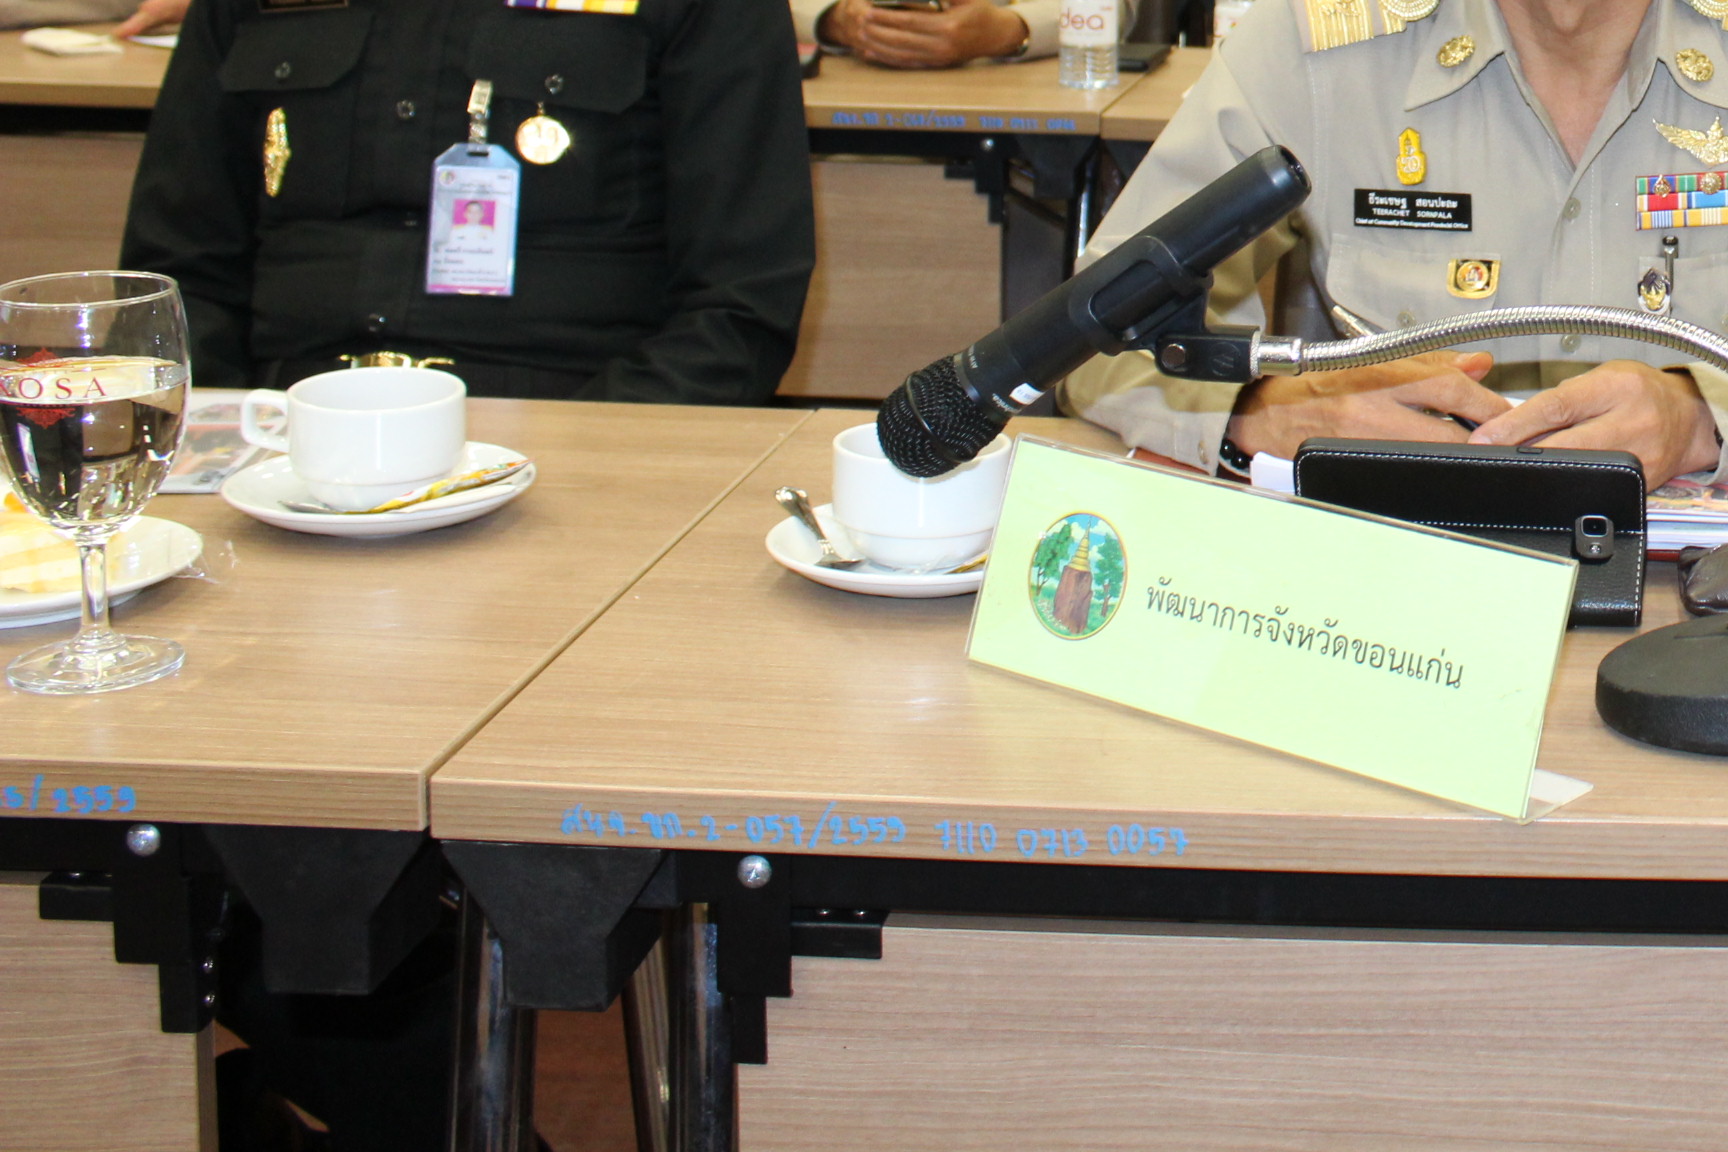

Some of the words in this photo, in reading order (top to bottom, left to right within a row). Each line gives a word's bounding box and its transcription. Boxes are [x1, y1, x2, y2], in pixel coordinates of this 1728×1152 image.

[1146, 577, 1464, 690] พัฒนาการจังหวัดขอนแก่น
[0, 774, 136, 814] 5/2559
[934, 820, 997, 855] 7110
[1016, 828, 1089, 858] 0713
[1107, 823, 1190, 857] 0057
